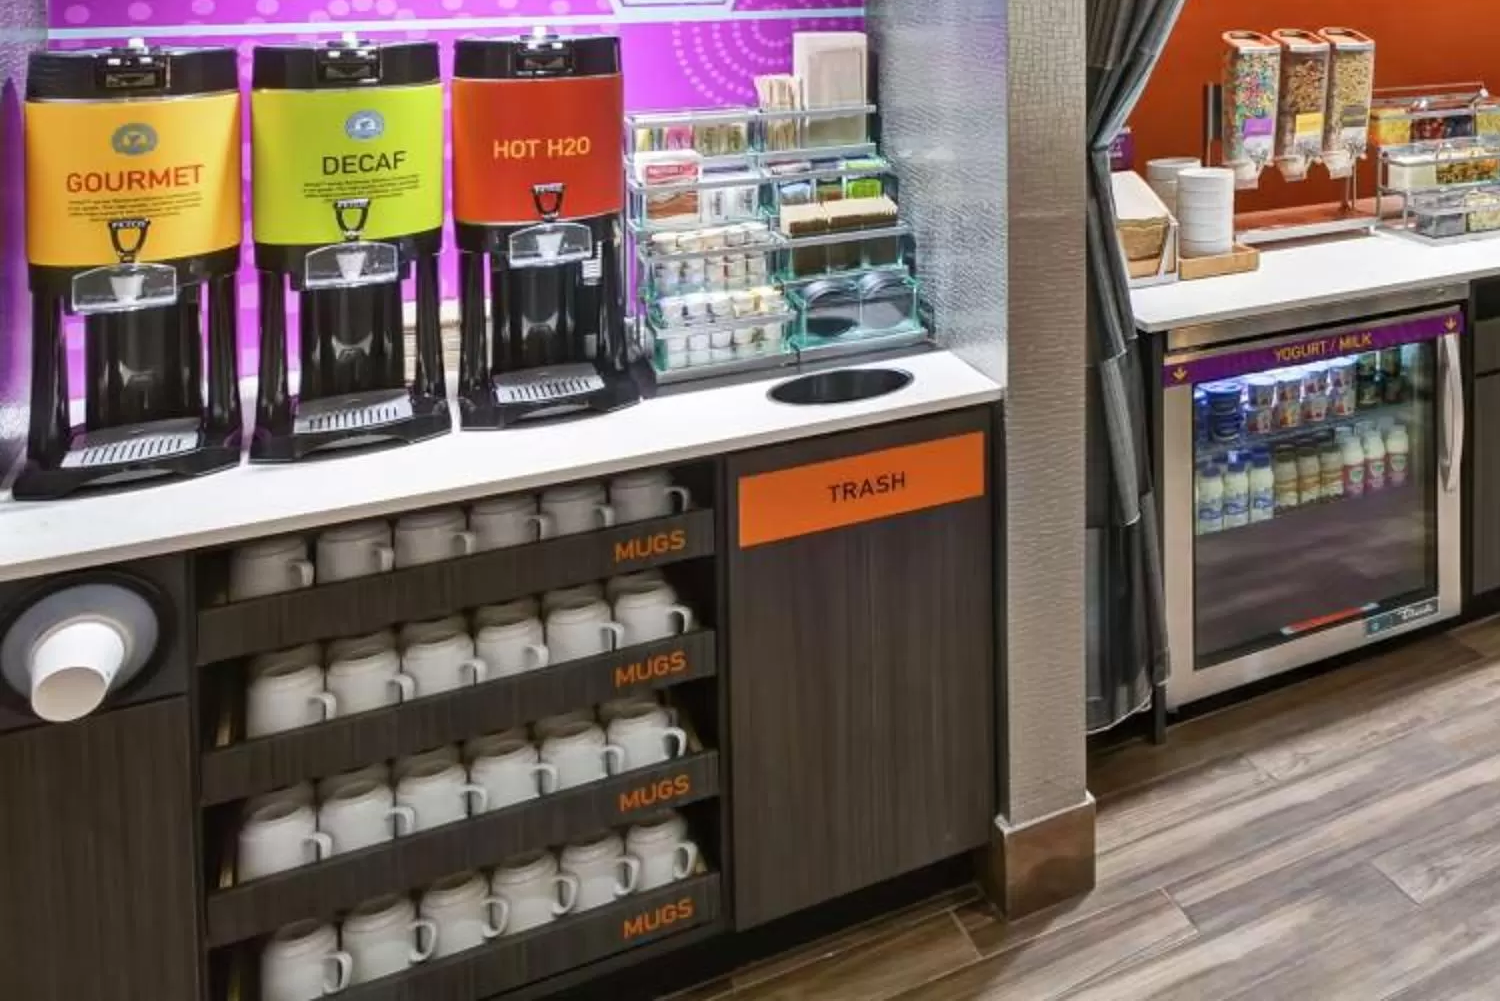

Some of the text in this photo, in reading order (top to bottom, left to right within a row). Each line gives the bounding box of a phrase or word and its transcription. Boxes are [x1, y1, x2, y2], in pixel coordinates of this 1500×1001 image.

[322, 150, 407, 175] DECAF
[493, 139, 541, 159] HOT
[66, 164, 205, 193] GOURMET
[1274, 341, 1327, 361] YOGURT
[1340, 332, 1373, 351] MILK
[827, 471, 906, 503] TRASH
[615, 529, 686, 563] MUGS
[615, 650, 687, 687] MUGS
[619, 774, 690, 812] MUGS
[624, 898, 693, 939] MUGS
